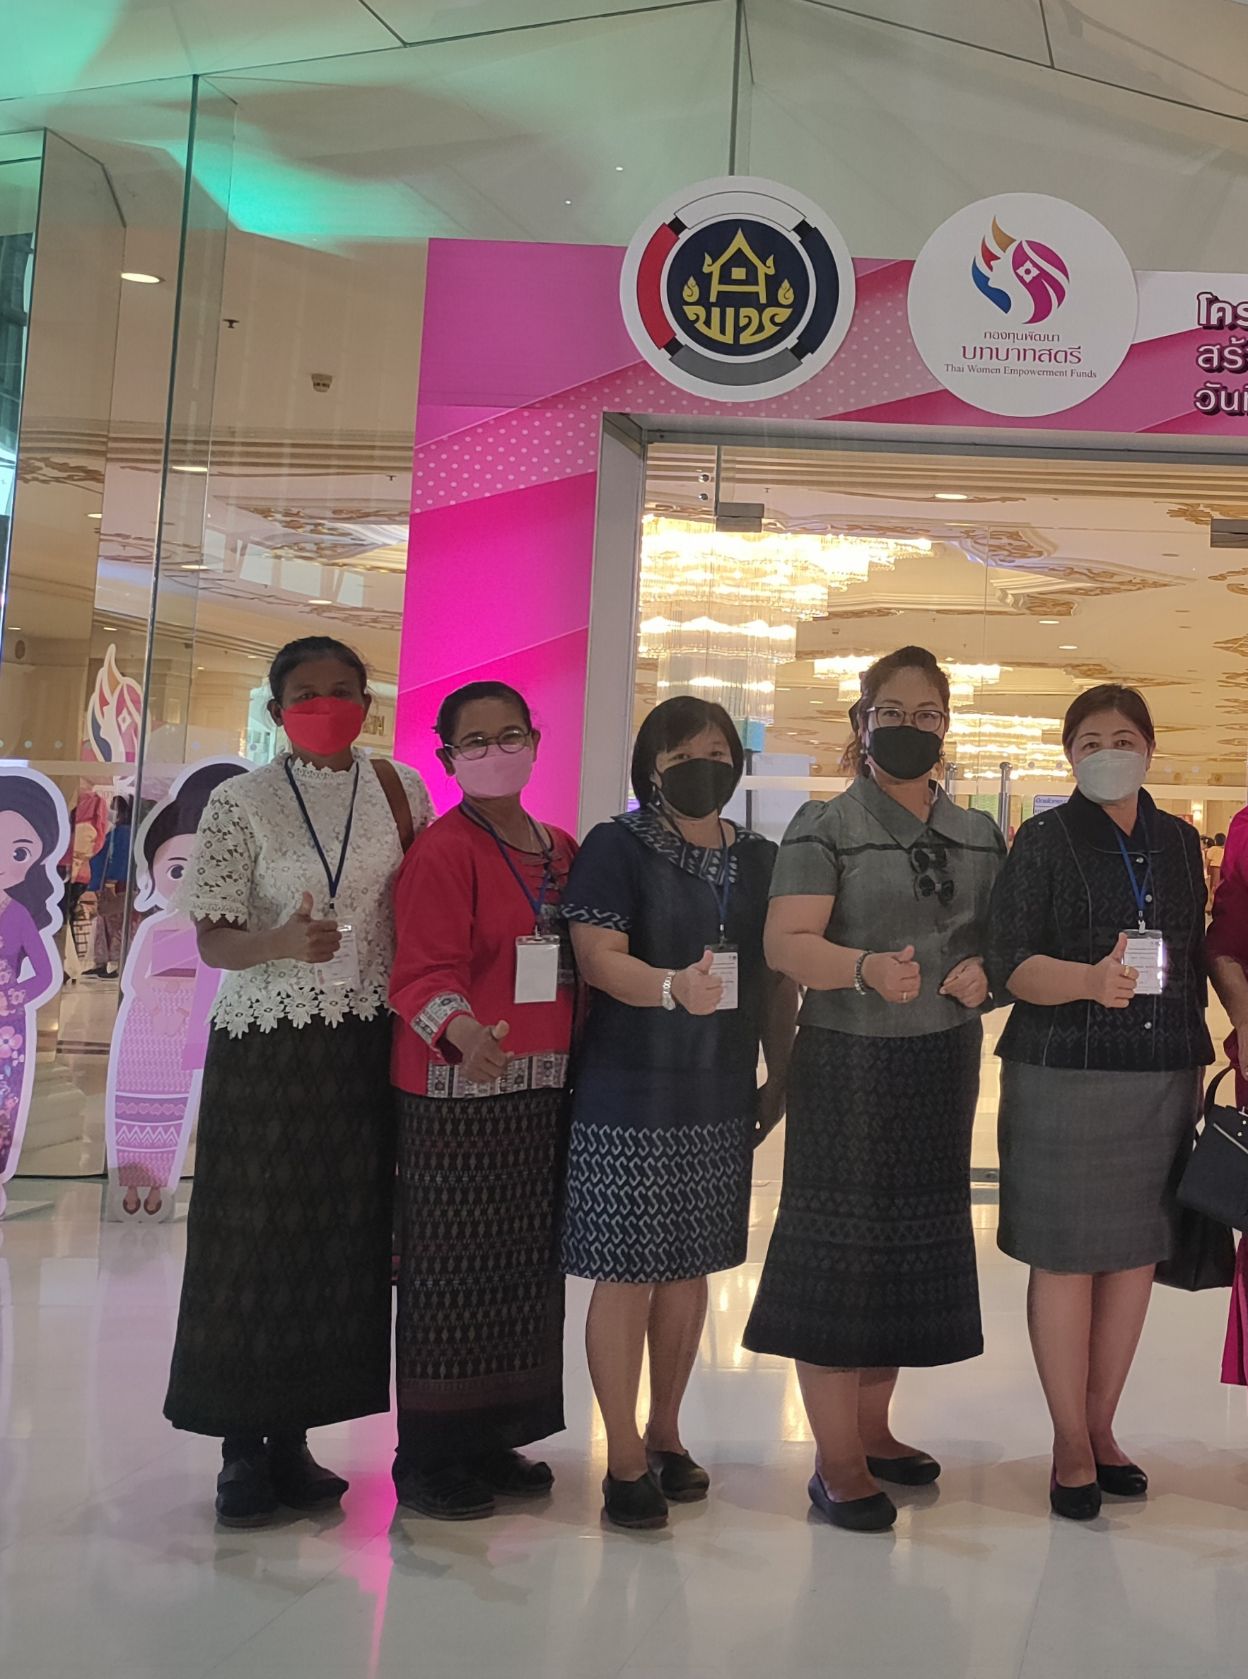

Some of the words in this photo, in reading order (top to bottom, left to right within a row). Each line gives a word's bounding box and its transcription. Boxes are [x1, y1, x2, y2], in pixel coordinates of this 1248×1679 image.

[983, 330, 1060, 344] กองทุนพัฒนา
[962, 345, 1082, 364] บทบาทสตรี
[944, 363, 965, 373] Thai
[967, 364, 1001, 374] Women
[1003, 366, 1067, 378] Empowerment
[1070, 369, 1097, 379] Funds
